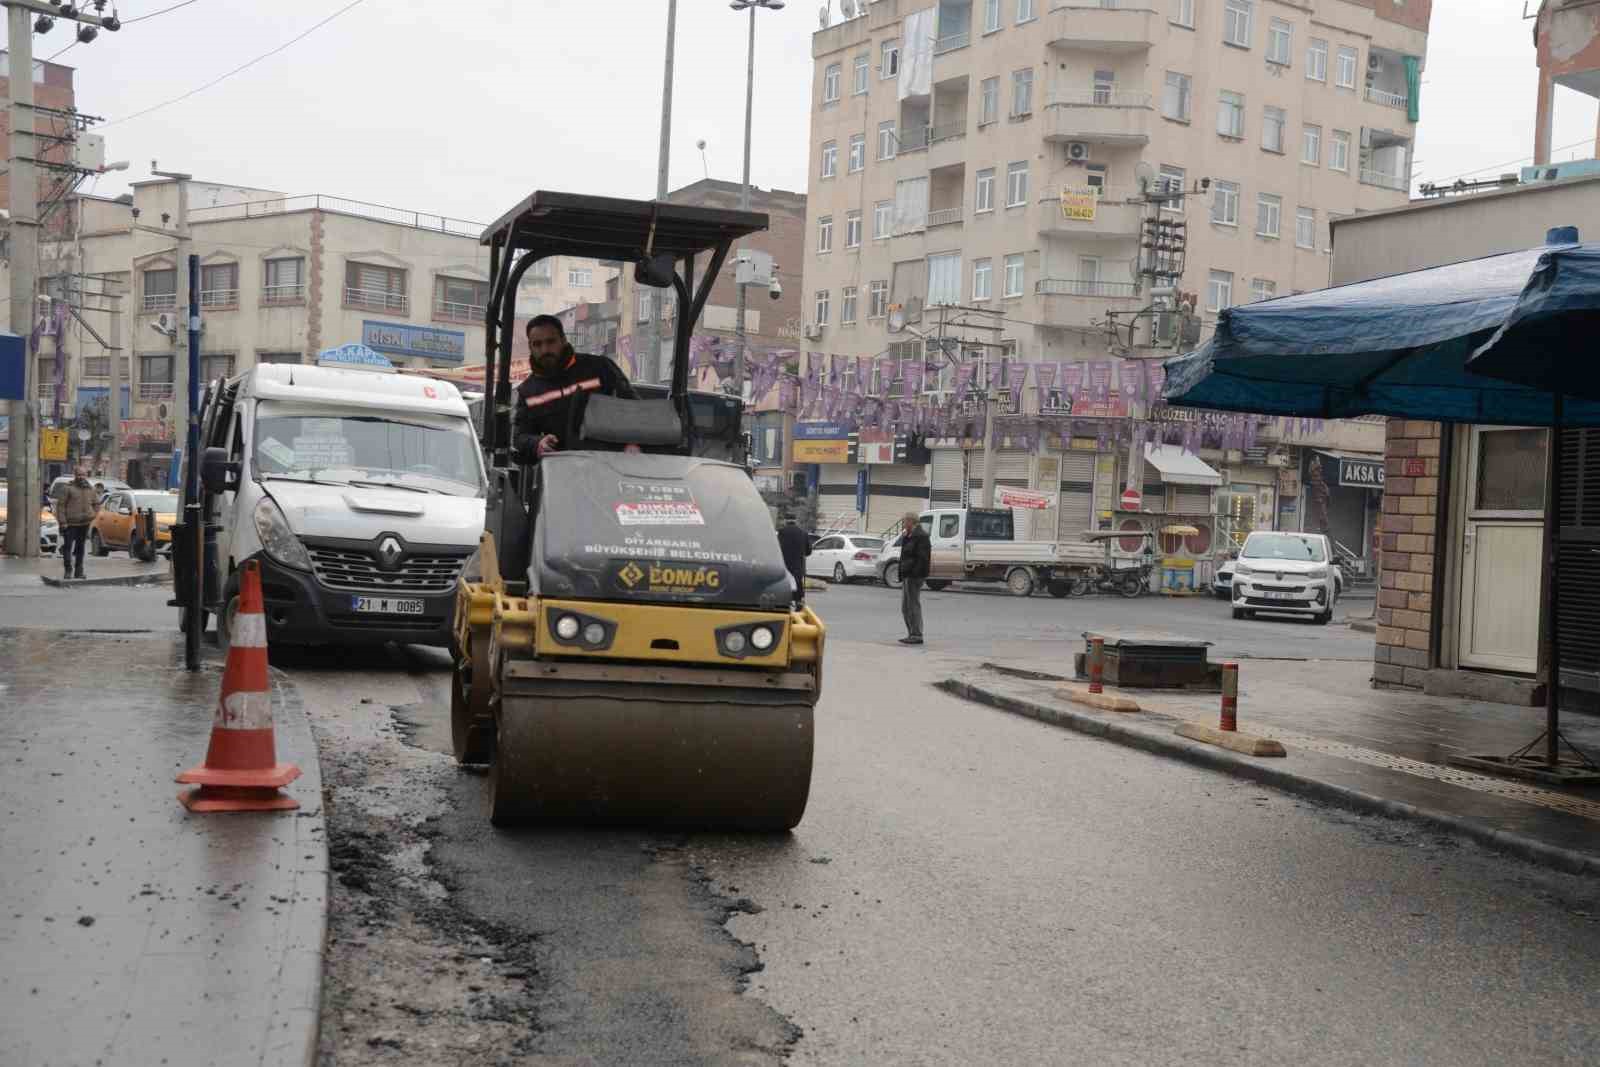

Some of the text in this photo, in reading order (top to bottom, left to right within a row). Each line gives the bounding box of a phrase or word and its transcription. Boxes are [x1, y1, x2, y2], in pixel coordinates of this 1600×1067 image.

[1345, 464, 1375, 482] AKSA
[359, 598, 423, 613] 21 M 0085
